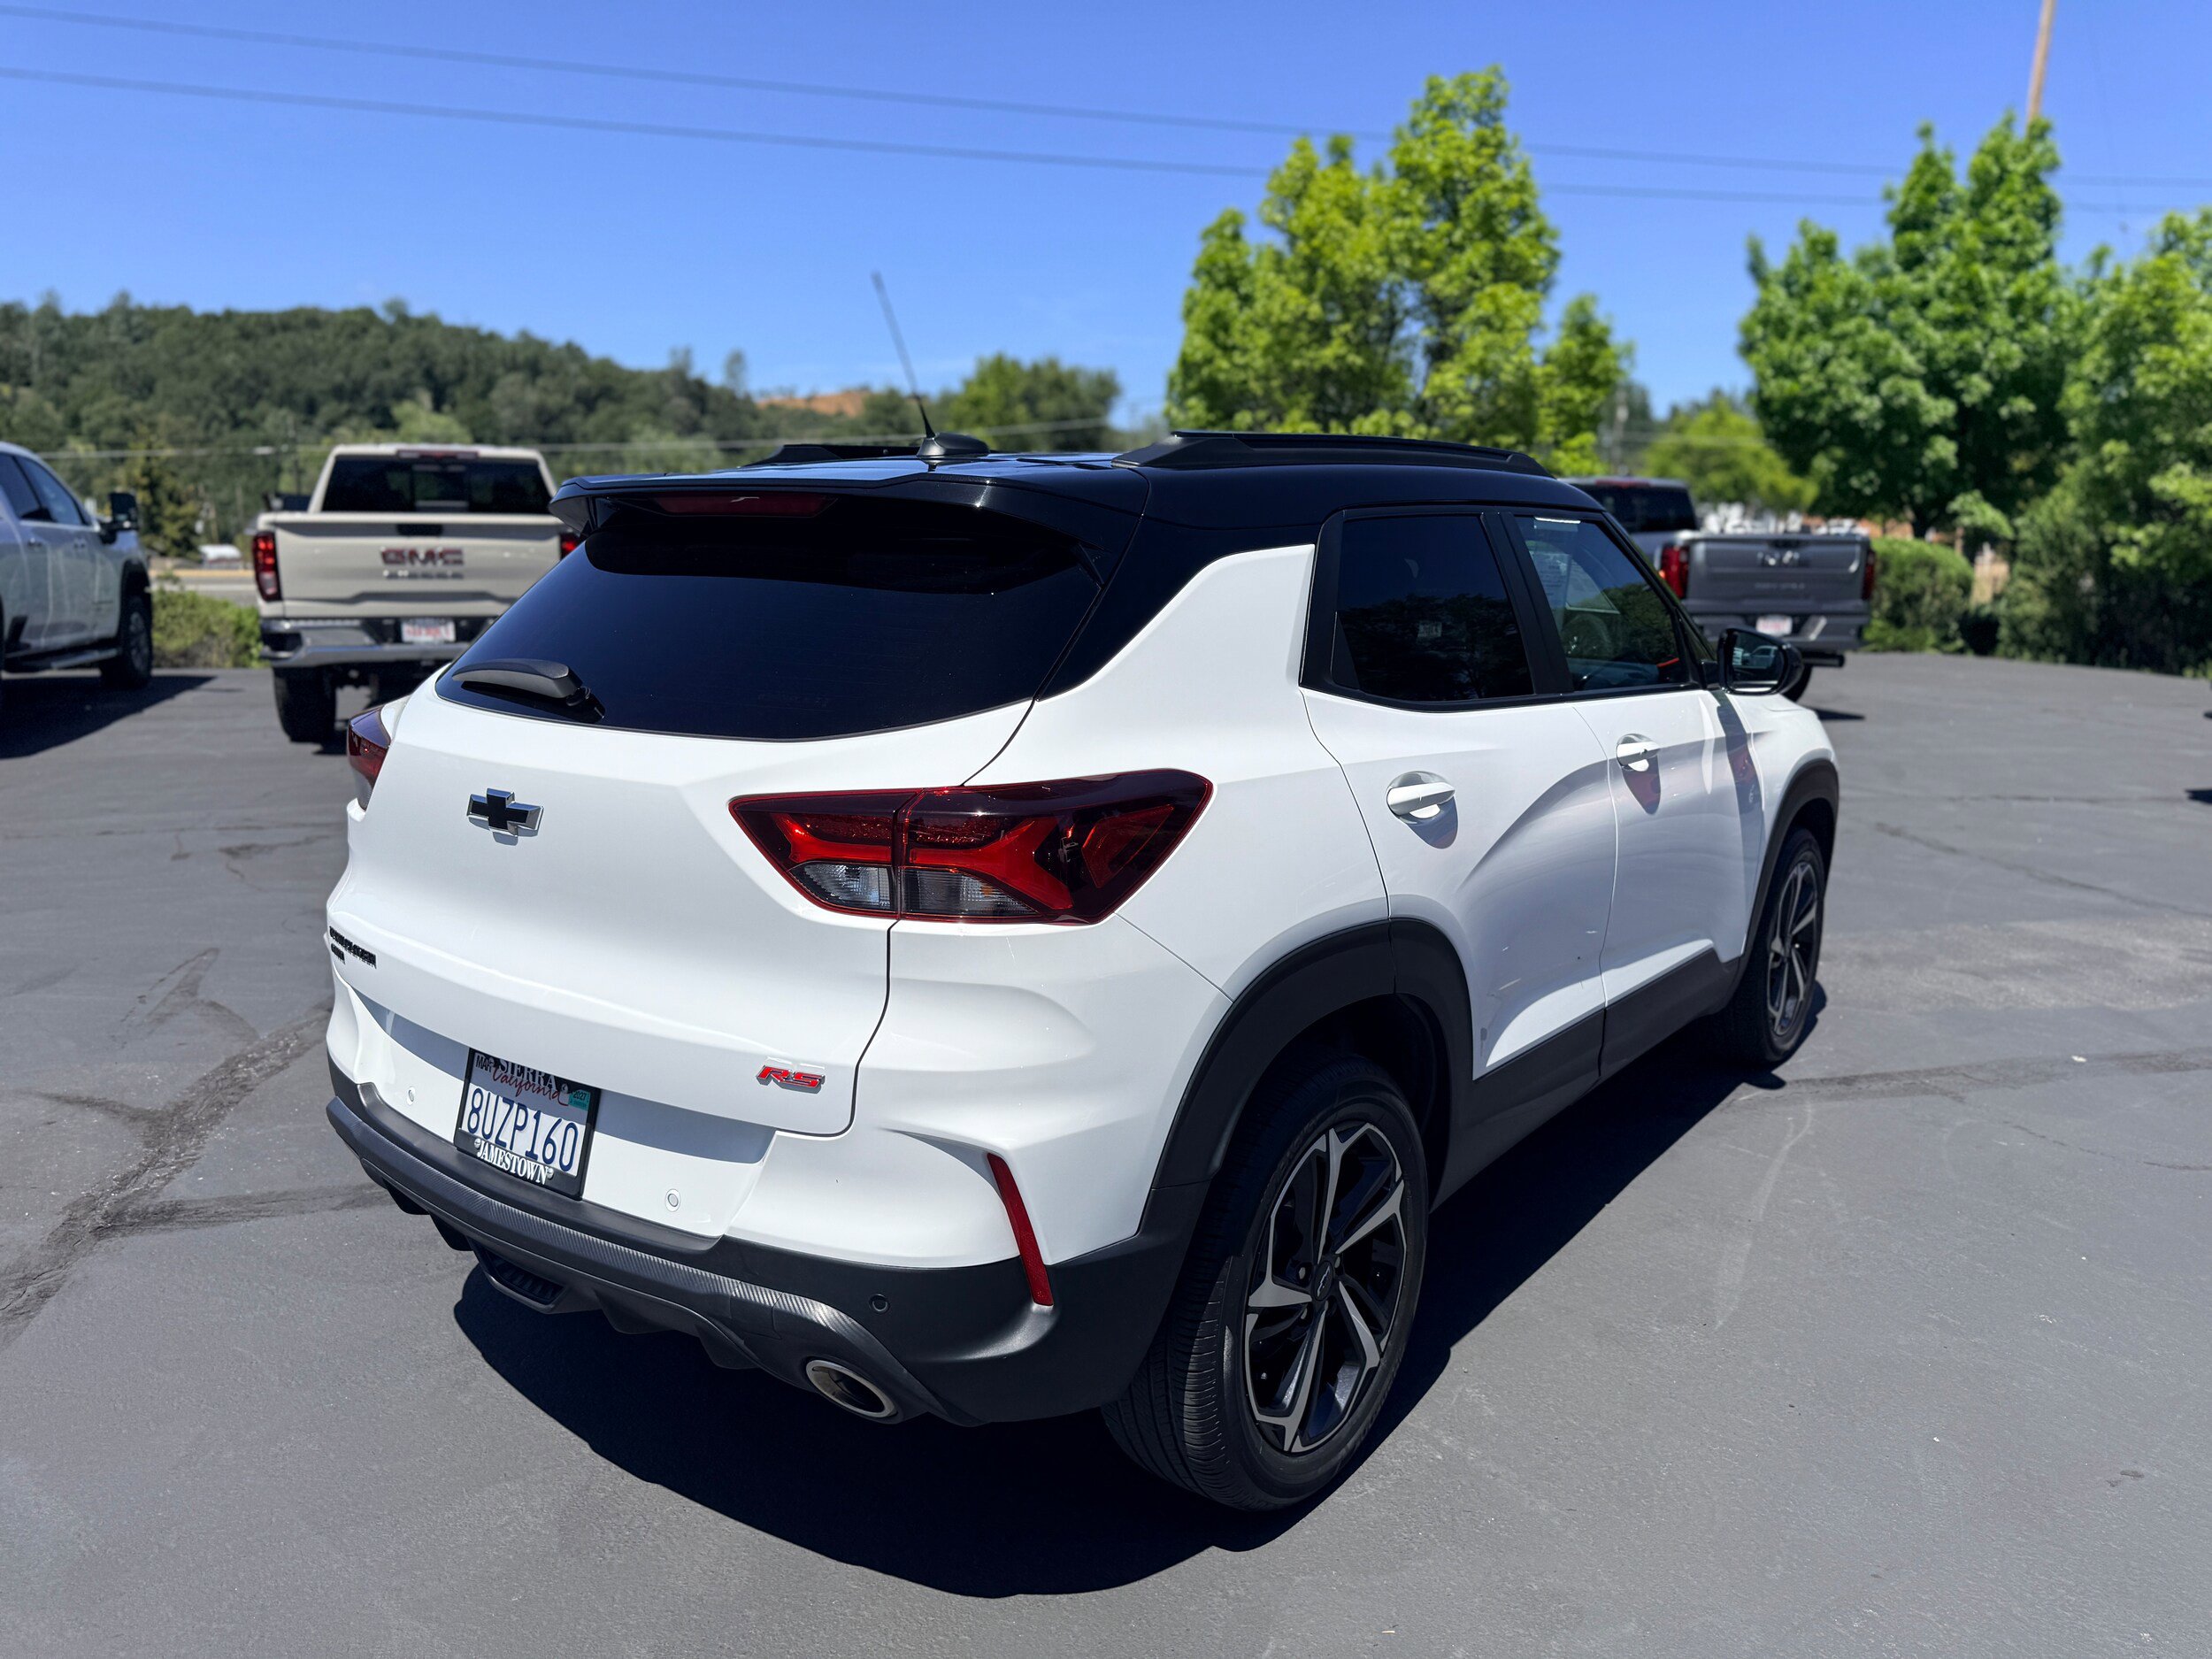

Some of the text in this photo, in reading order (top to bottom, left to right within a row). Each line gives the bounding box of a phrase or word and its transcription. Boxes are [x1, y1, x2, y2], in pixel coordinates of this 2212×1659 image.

[380, 547, 464, 565] GMC
[498, 1058, 557, 1092] SIERRA
[756, 1064, 825, 1090] RS
[467, 1087, 579, 1171] 8UZP160
[476, 1138, 549, 1185] JAMESTOWN
